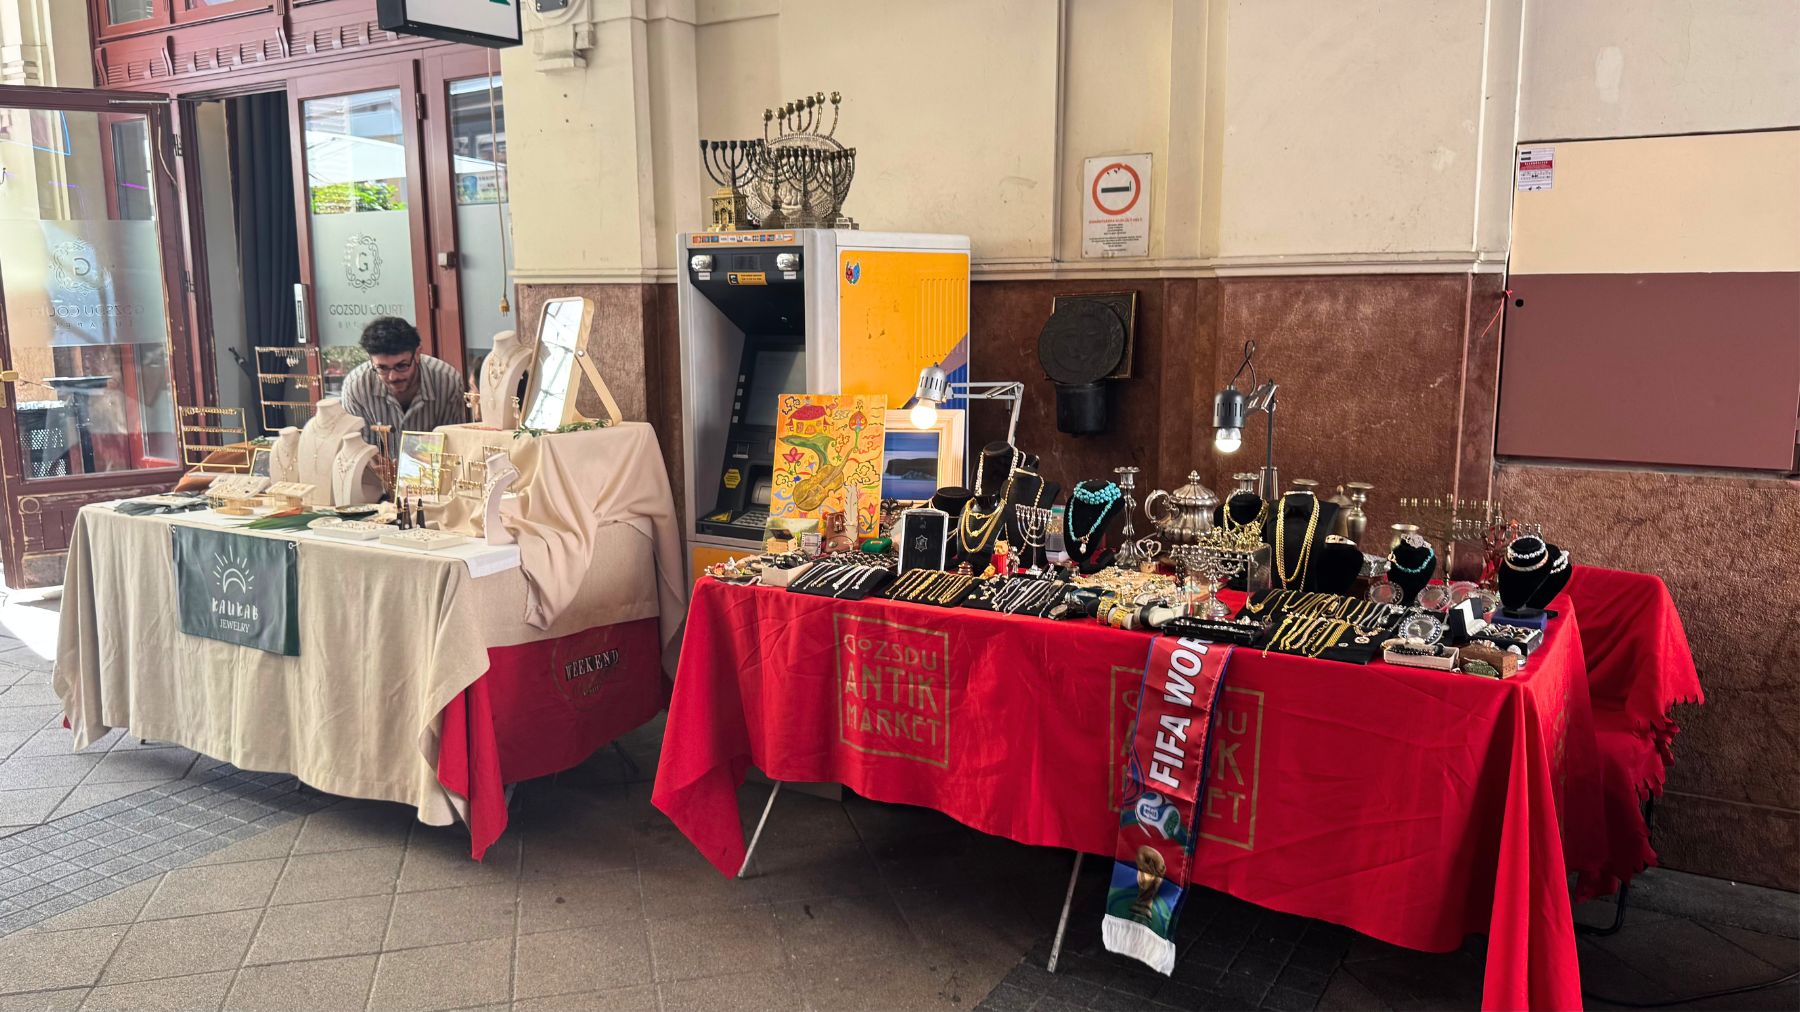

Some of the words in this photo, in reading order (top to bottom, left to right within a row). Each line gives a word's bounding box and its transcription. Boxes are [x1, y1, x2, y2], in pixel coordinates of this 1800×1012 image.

[356, 252, 369, 272] G
[329, 304, 368, 316] GOZSDU
[370, 304, 404, 316] COURT
[212, 597, 259, 621] KAUKAB
[220, 618, 250, 633] JEWELRY
[565, 649, 619, 680] WEEKEND
[844, 633, 937, 671] GOZSDU
[845, 661, 938, 714] ANTIK
[846, 700, 941, 746] MARKET
[1149, 714, 1191, 788] FIFA
